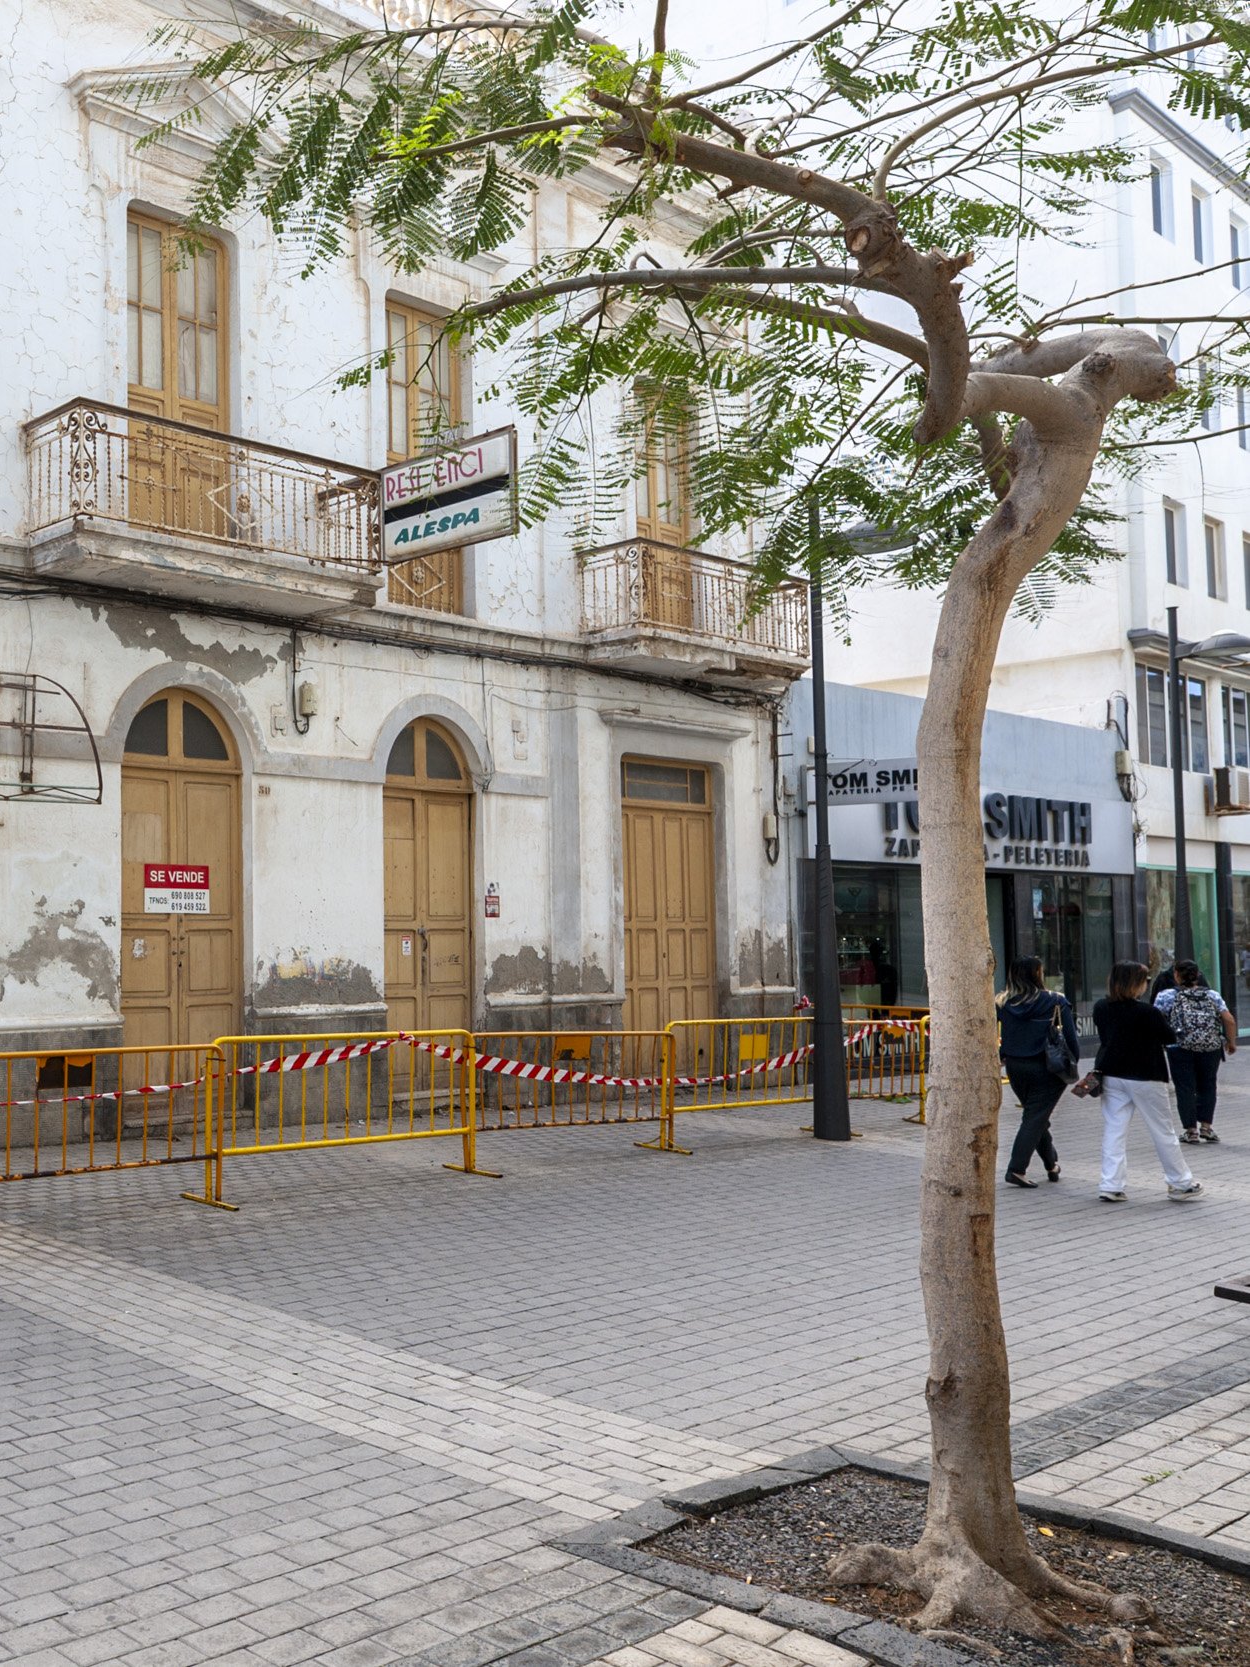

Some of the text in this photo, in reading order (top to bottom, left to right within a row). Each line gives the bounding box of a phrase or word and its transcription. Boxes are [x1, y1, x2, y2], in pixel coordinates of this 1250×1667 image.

[394, 508, 480, 545] ALESPA
[828, 768, 918, 788] OM SMI
[828, 787, 881, 796] APATERIA
[984, 792, 1092, 845] SMITH
[1003, 845, 1090, 867] PELETERIA
[150, 870, 205, 883] SE VENDE
[171, 891, 182, 900] 690
[196, 892, 206, 900] 527
[171, 902, 182, 911] 619
